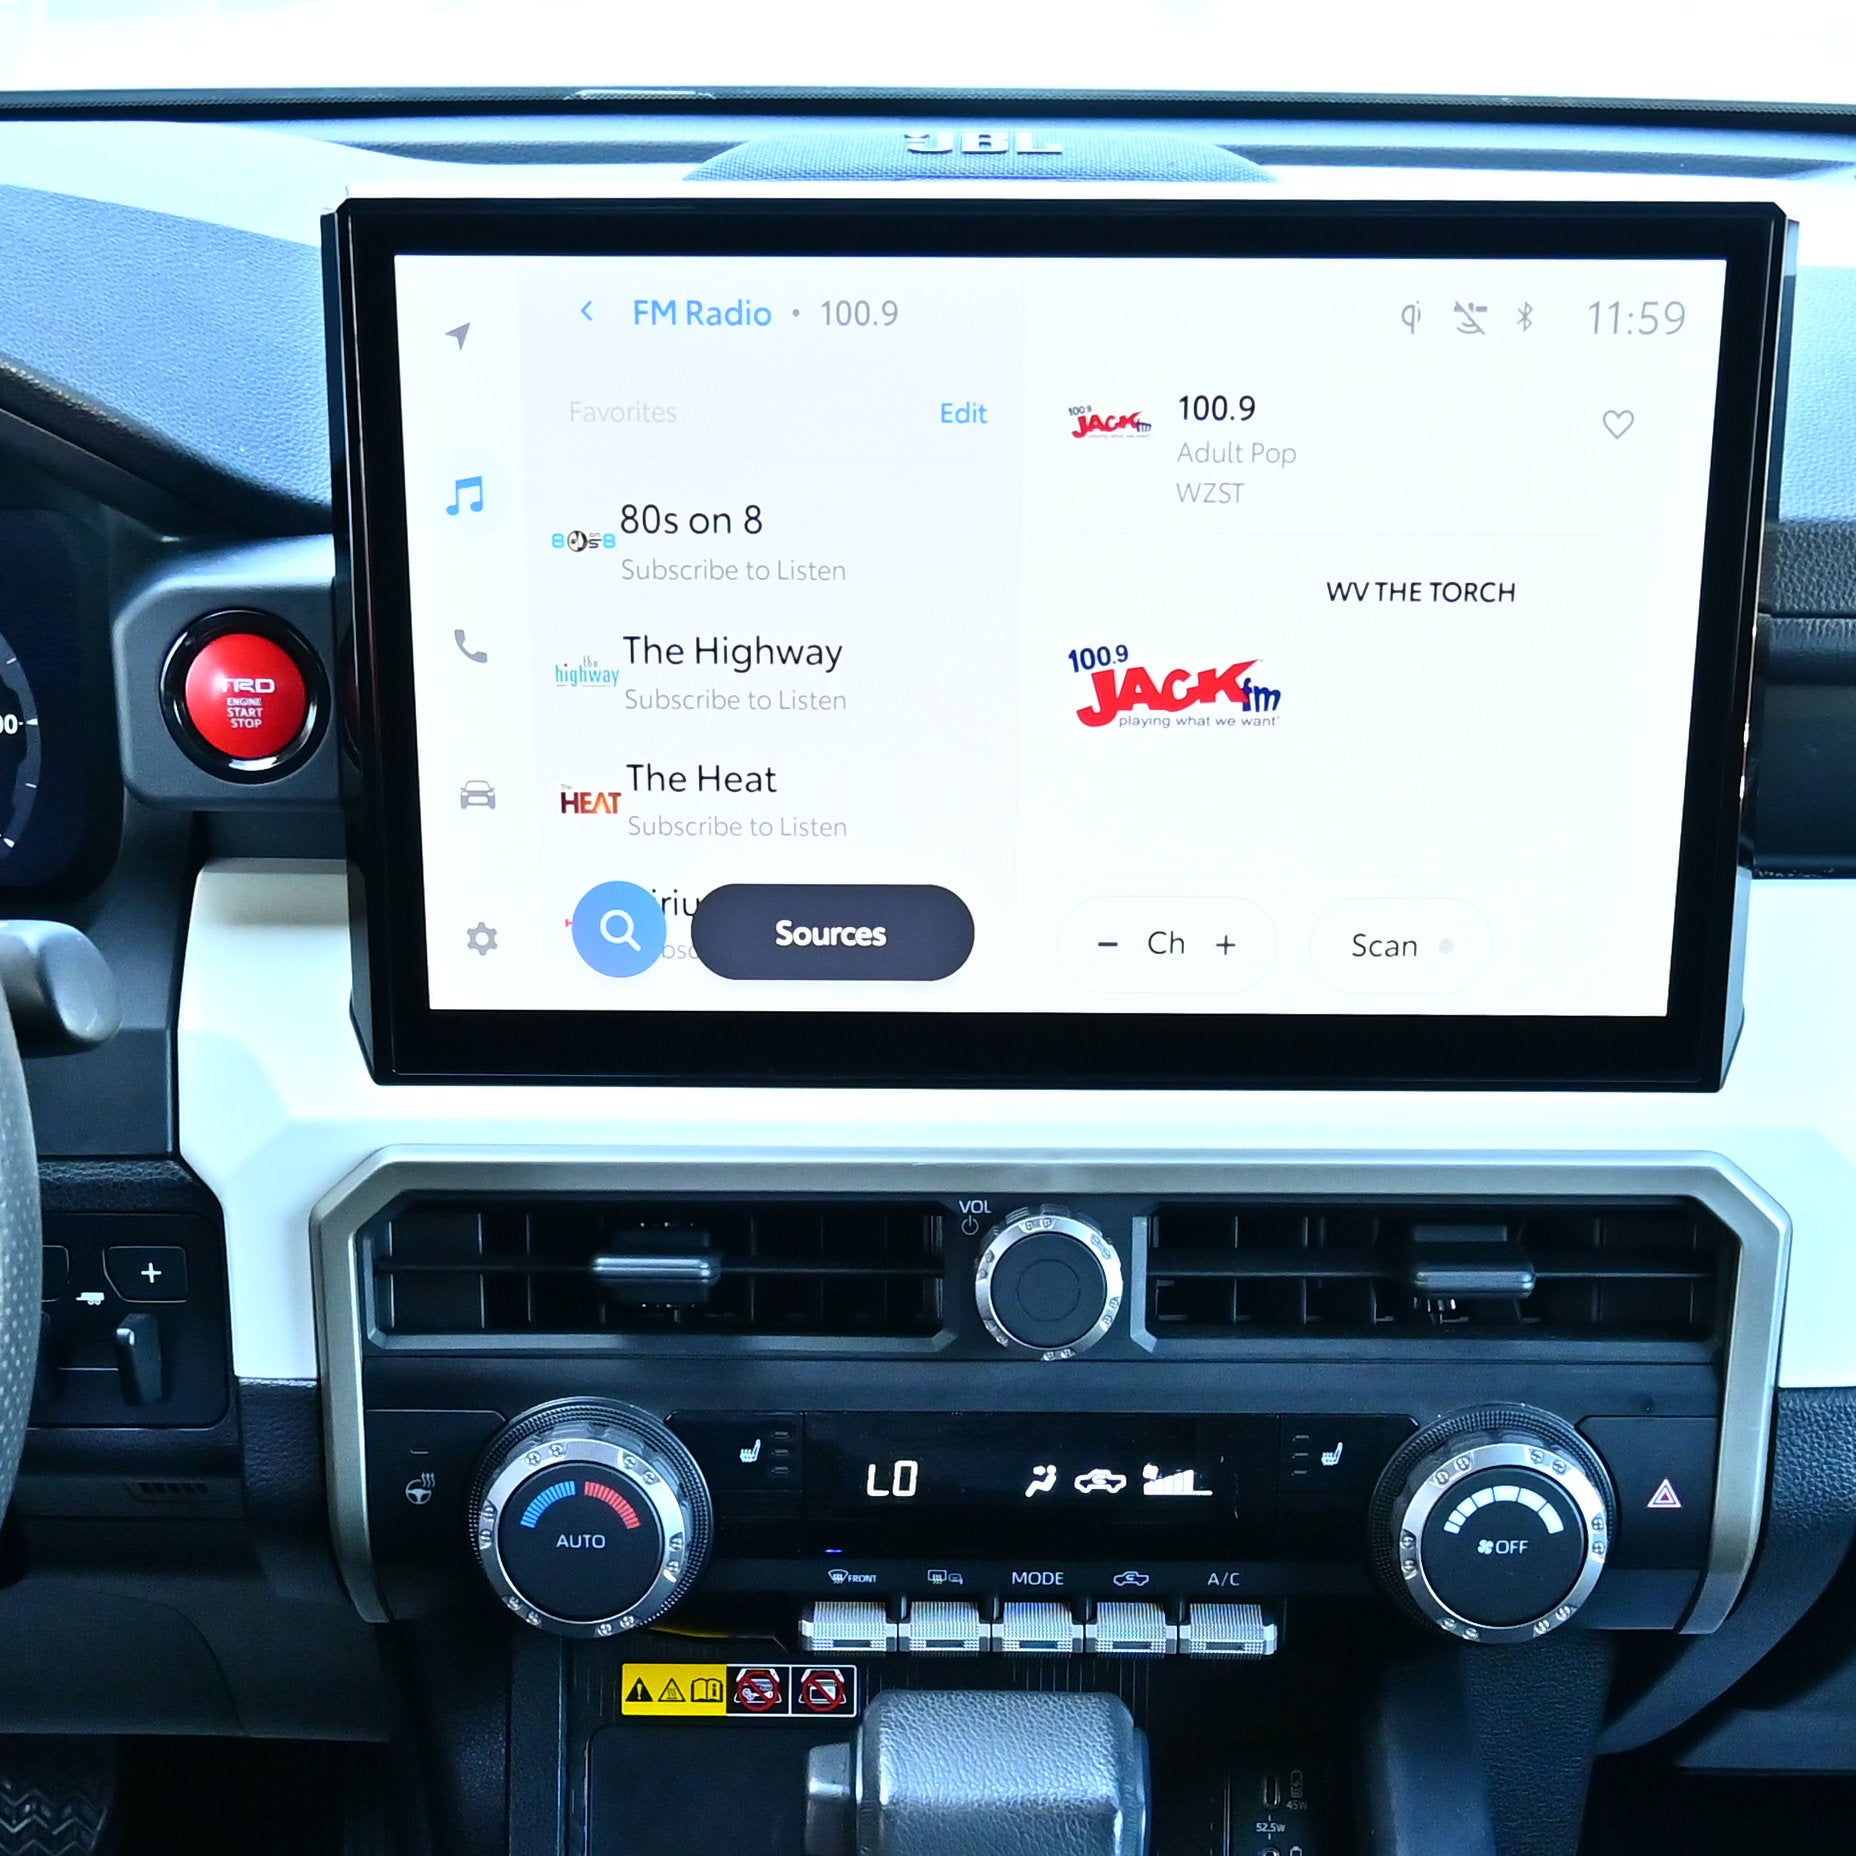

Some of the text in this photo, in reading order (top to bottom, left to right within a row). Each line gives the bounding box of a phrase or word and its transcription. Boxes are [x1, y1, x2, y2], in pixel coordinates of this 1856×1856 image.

[633, 298, 899, 327] FM Radio 100.9
[1588, 300, 1685, 335] 11:59
[569, 400, 677, 424] Favorites
[940, 401, 988, 424] Edit
[1179, 394, 1256, 422] 100.9
[1071, 411, 1143, 439] JACK
[1177, 441, 1297, 469] Adult Pop
[1176, 482, 1245, 504] WZST
[620, 504, 763, 534] 80s on 8
[621, 558, 846, 581] Subscribe to Listen
[1326, 582, 1515, 603] WV THE TORCH
[622, 635, 843, 673] The Highway
[1068, 643, 1129, 673] 100.9
[215, 677, 276, 694] TRD
[555, 664, 619, 687] highway
[624, 688, 847, 711] Subscribe to Listen
[1076, 659, 1259, 728] JACK
[227, 707, 263, 718] START
[231, 718, 263, 728] STOP
[1119, 714, 1276, 729] playing what we want
[626, 763, 778, 793] The Heat
[560, 791, 622, 814] HEAT
[628, 815, 847, 837] Subscribe to Listen
[775, 919, 887, 948] Sources
[1147, 930, 1187, 955] Ch
[1351, 932, 1418, 959] Scan
[959, 1200, 992, 1215] VOL
[556, 1534, 606, 1549] AUTO
[1495, 1539, 1529, 1555] OFF
[848, 1573, 877, 1584] FRONT
[1012, 1571, 1064, 1585] MODE
[1207, 1572, 1240, 1587] A/C
[1256, 1822, 1286, 1833] 52.5W
